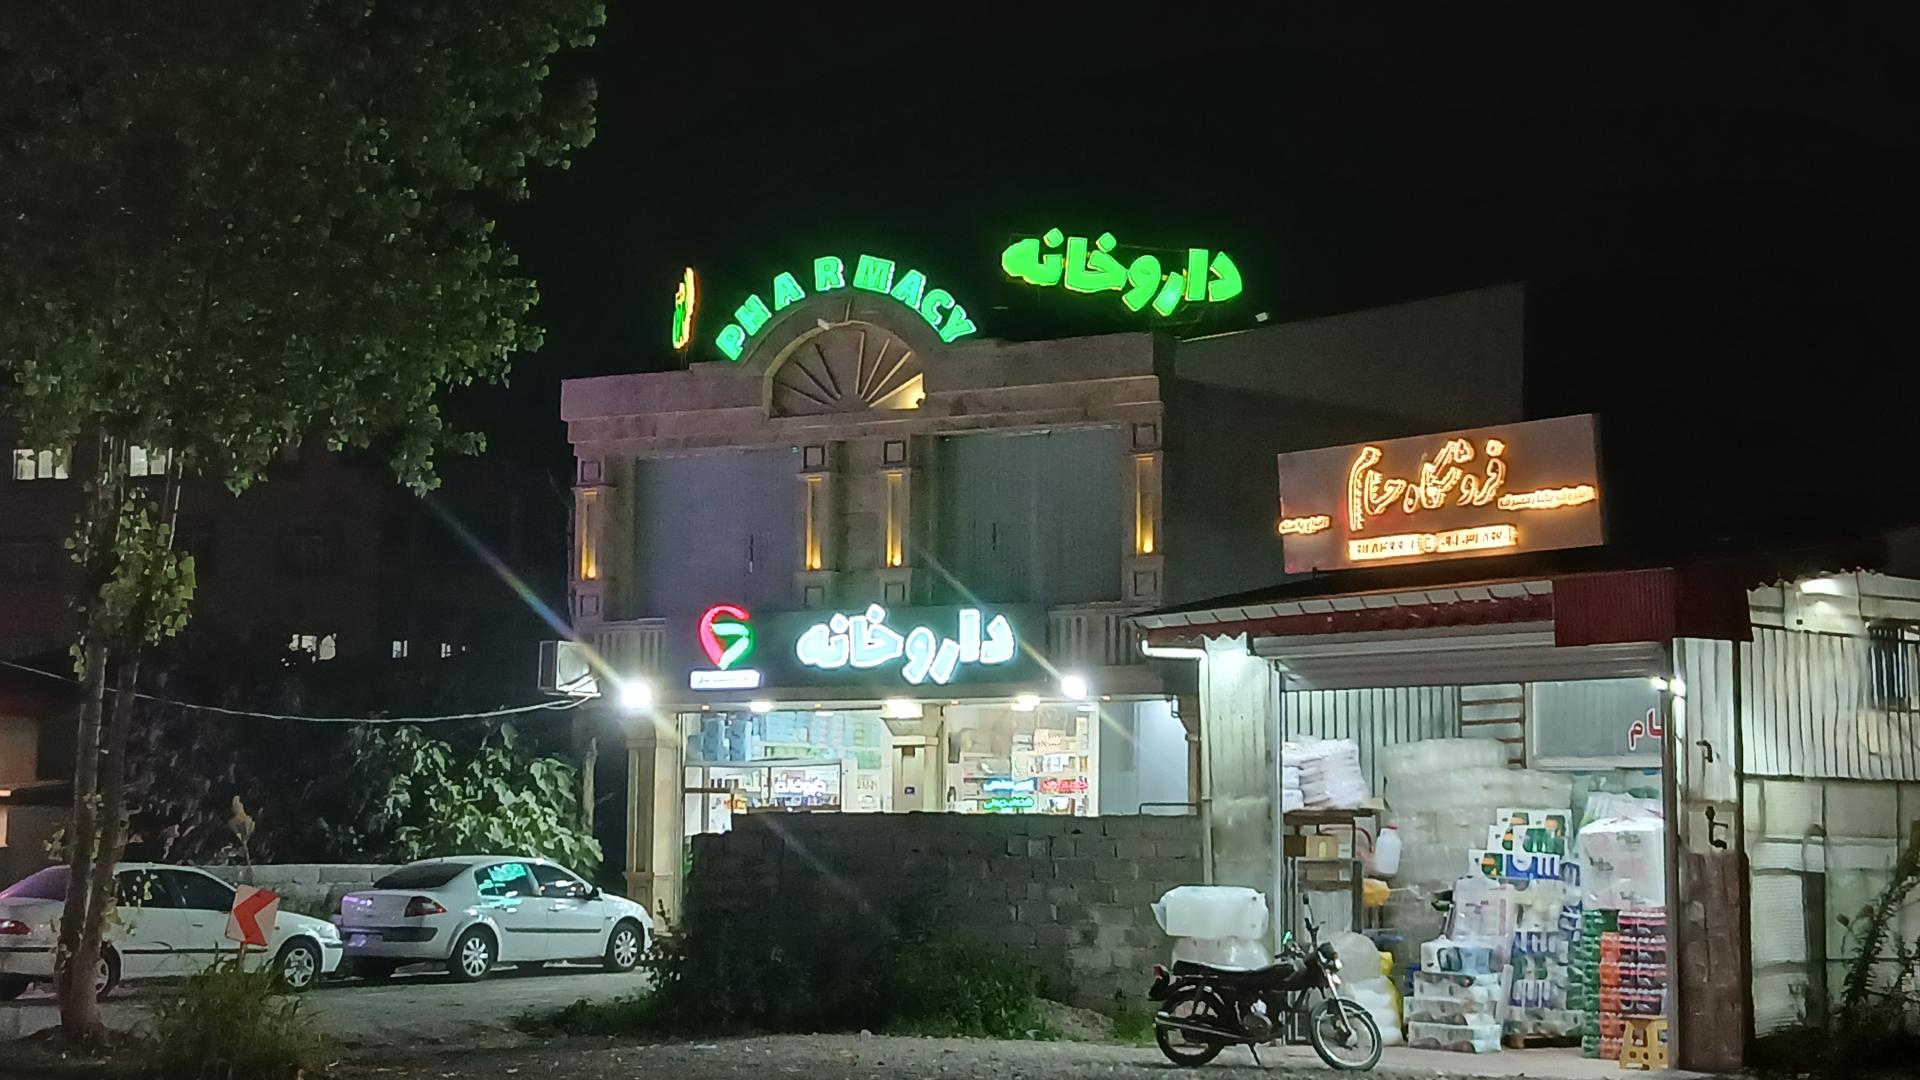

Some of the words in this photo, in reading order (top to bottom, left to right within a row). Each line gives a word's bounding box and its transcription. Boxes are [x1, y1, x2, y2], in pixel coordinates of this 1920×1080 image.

[714, 254, 977, 361] PHARMACY
[1001, 227, 1243, 318] داروخانه
[1402, 436, 1508, 515] فروشگاه
[796, 602, 1017, 685] داروخانه
